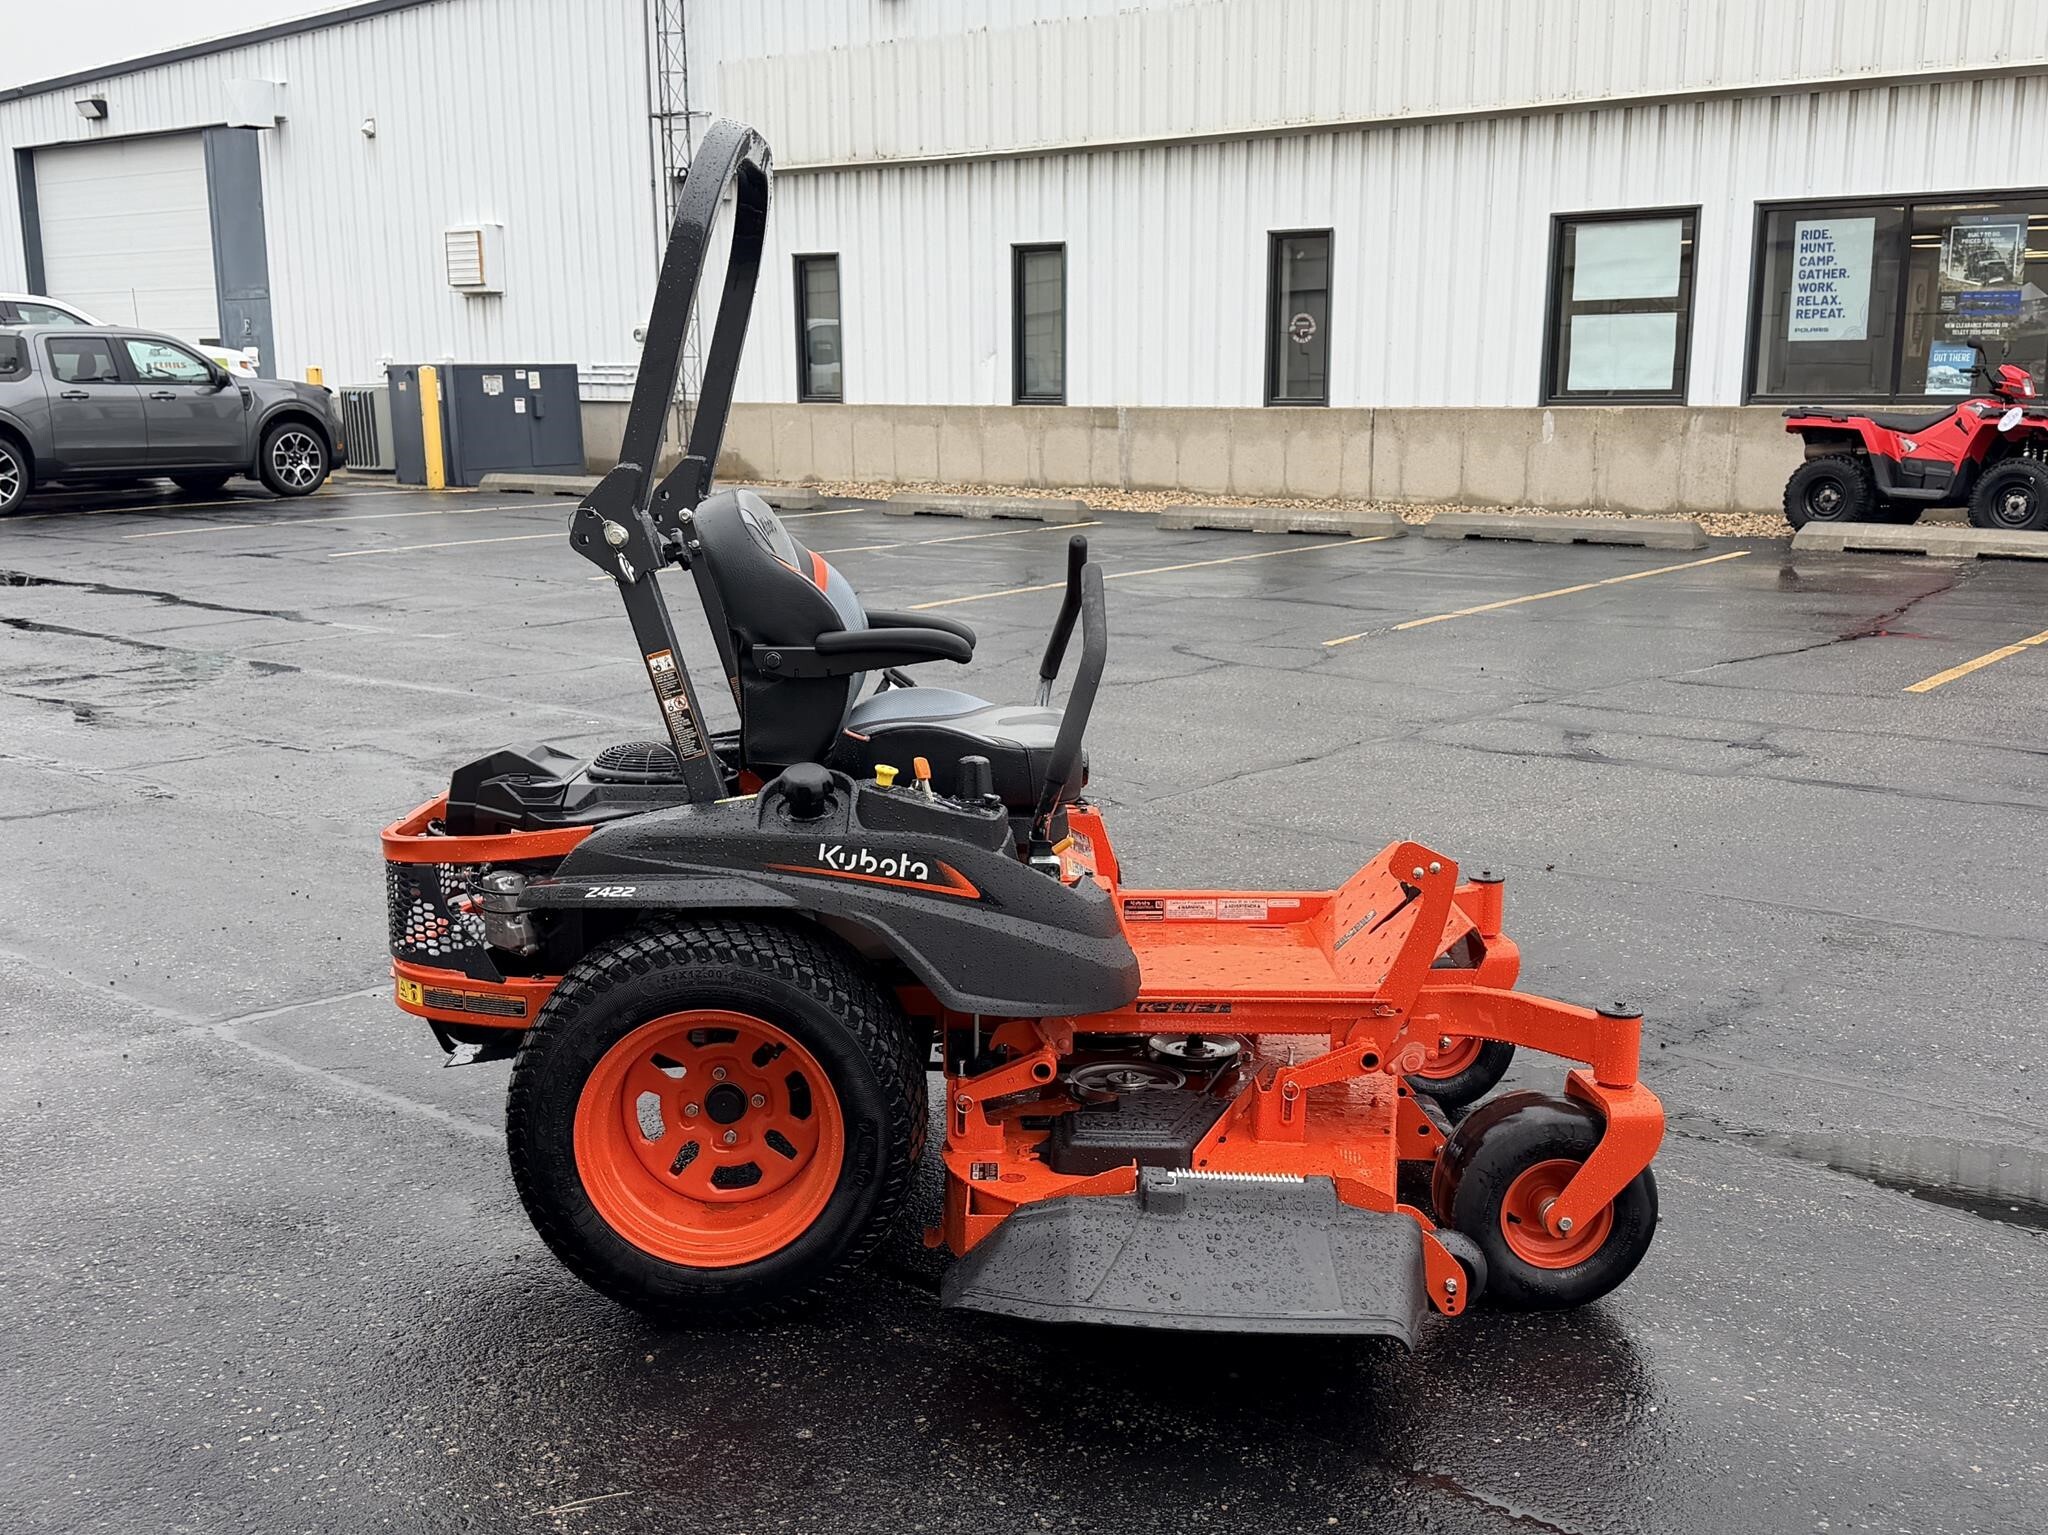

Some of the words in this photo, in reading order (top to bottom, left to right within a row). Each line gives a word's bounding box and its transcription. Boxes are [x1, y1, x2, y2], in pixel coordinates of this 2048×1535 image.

[1801, 229, 1832, 240] RIDE.
[1800, 242, 1836, 253] HUNT.
[1799, 255, 1837, 267] CAMP.
[1798, 268, 1850, 280] GATHER.
[1798, 282, 1837, 293] WORK.
[1796, 295, 1842, 306] RELAX.
[1795, 308, 1846, 319] REPEAT.
[1933, 353, 1947, 362] OUT
[1948, 353, 1971, 362] THERE
[818, 843, 929, 880] Kubota
[584, 886, 637, 898] Z422
[1139, 1002, 1230, 1012] K-LIFT
